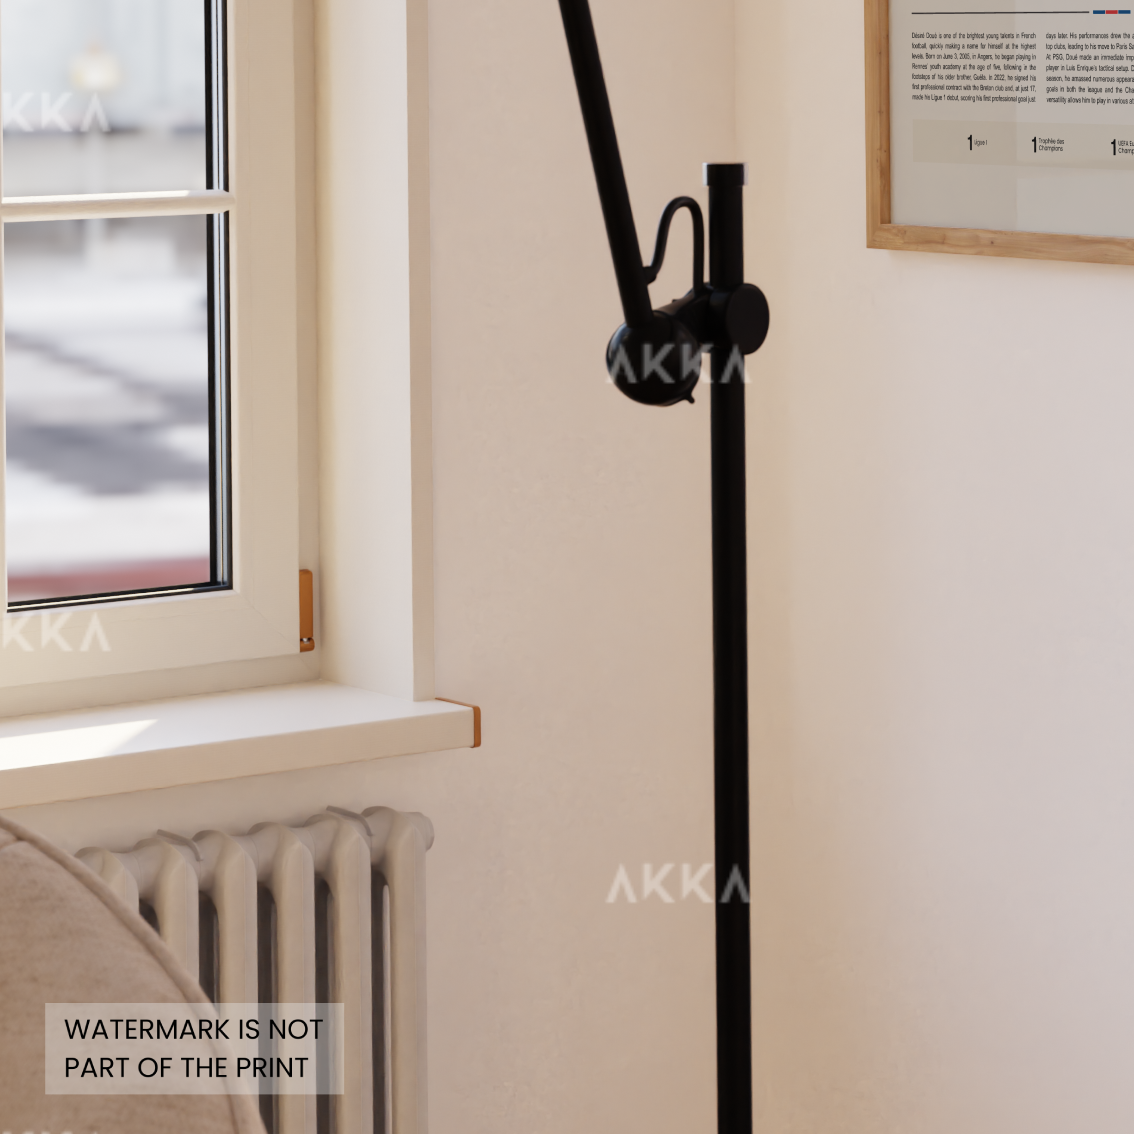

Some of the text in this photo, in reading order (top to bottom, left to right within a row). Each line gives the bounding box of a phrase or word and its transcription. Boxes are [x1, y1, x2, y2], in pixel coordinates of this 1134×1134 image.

[967, 134, 973, 151] 1
[1031, 136, 1037, 153] 1
[1110, 138, 1116, 156] 1
